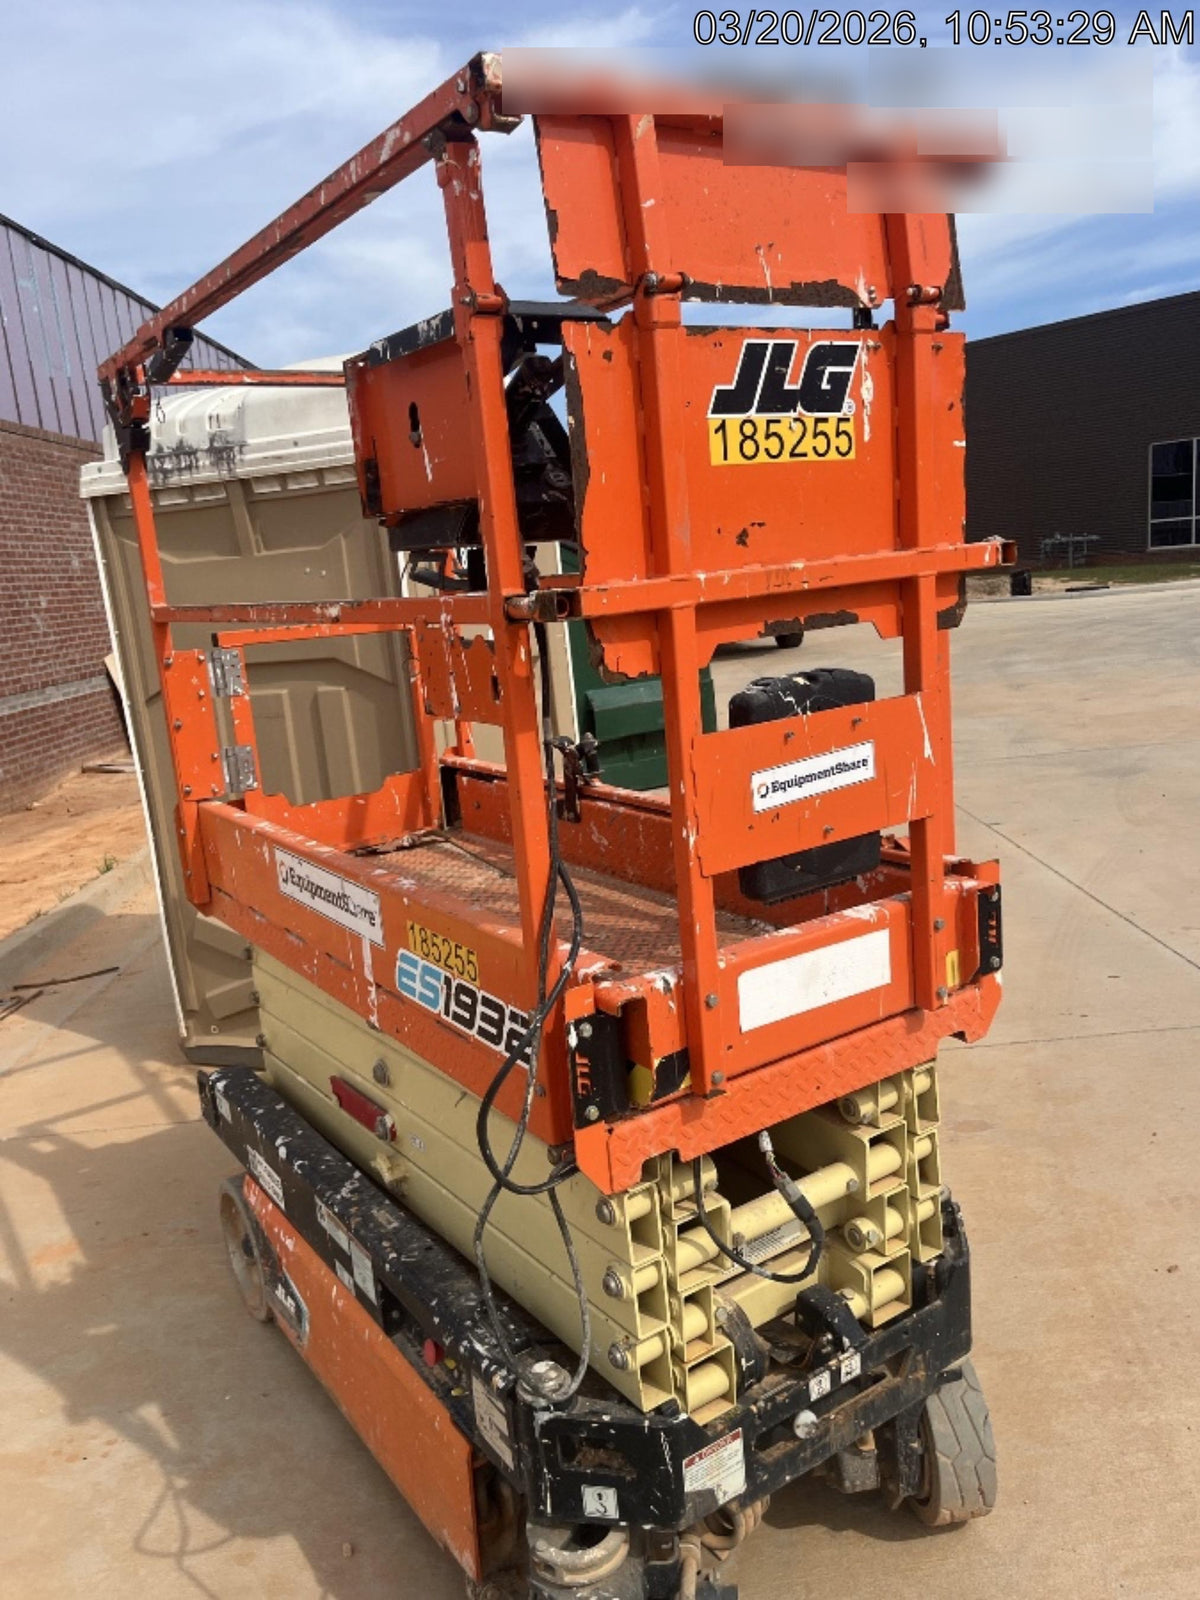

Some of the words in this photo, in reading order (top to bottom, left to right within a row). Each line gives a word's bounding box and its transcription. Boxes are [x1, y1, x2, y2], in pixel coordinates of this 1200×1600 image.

[708, 339, 862, 418] JLG
[714, 418, 853, 462] 185255
[771, 757, 869, 794] EquipmentShare
[408, 923, 478, 983] 185255
